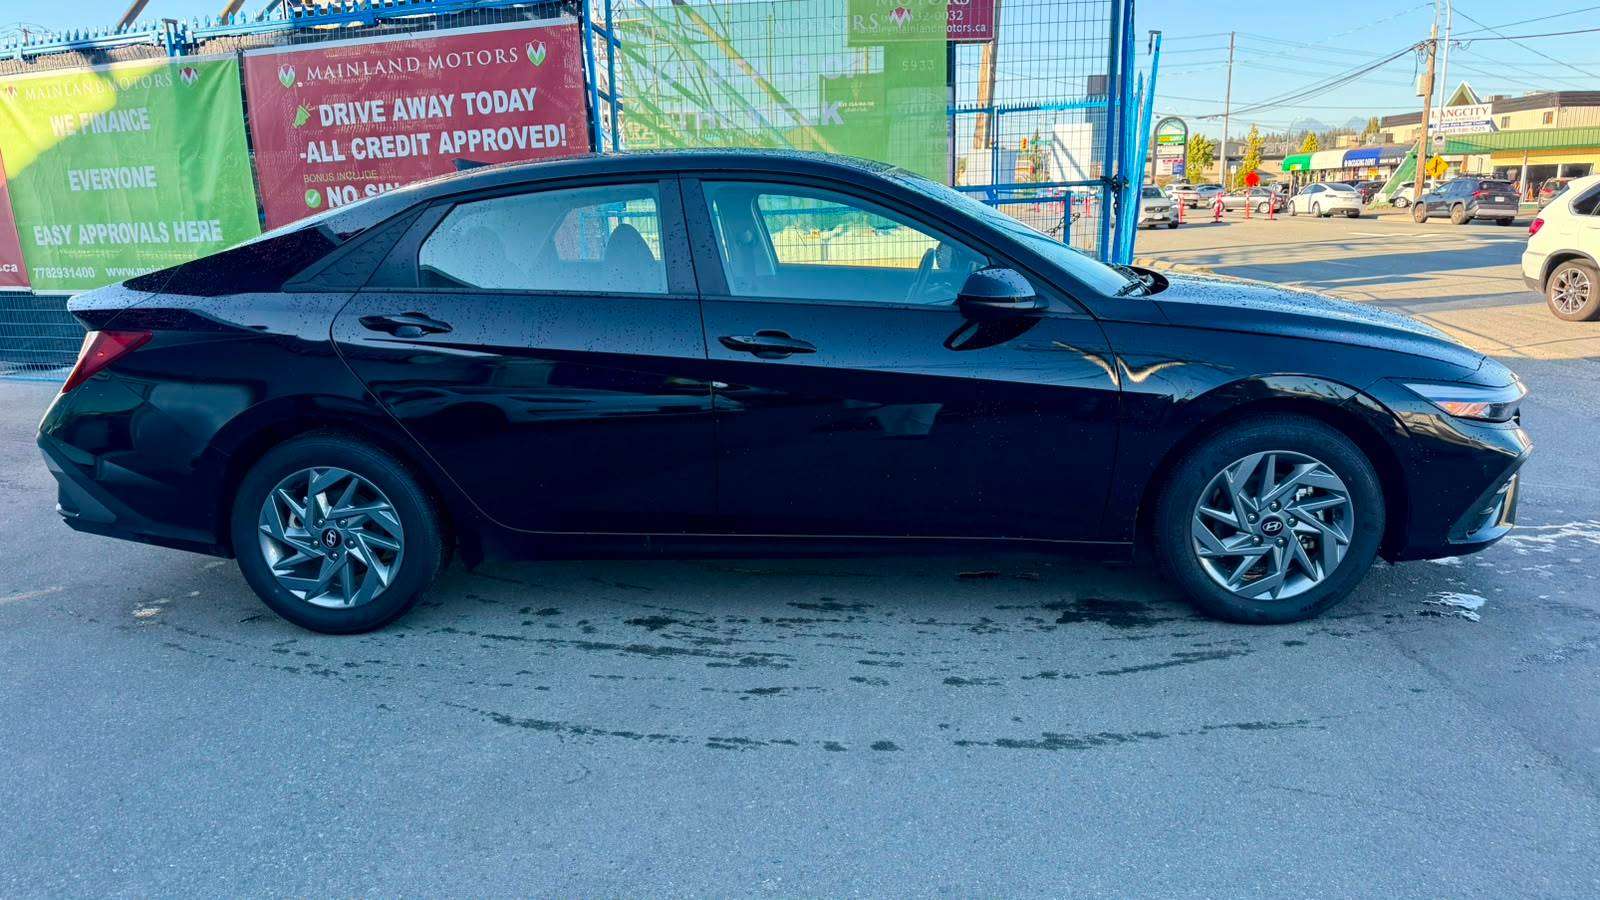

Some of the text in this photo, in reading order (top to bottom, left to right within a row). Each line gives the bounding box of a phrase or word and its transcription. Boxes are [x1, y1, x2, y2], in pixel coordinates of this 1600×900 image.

[307, 47, 518, 81] MAINLAND MOTORS
[51, 107, 151, 136] WE FINANCE
[319, 88, 537, 127] DRIVE AWAY TODAY
[351, 133, 430, 161] CREDIT
[439, 124, 567, 154] APPROVED!
[68, 166, 158, 192] EVERYONE
[304, 173, 334, 183] BONUS
[326, 185, 358, 208] NO
[33, 219, 224, 247] EASY APPROVALS HERE
